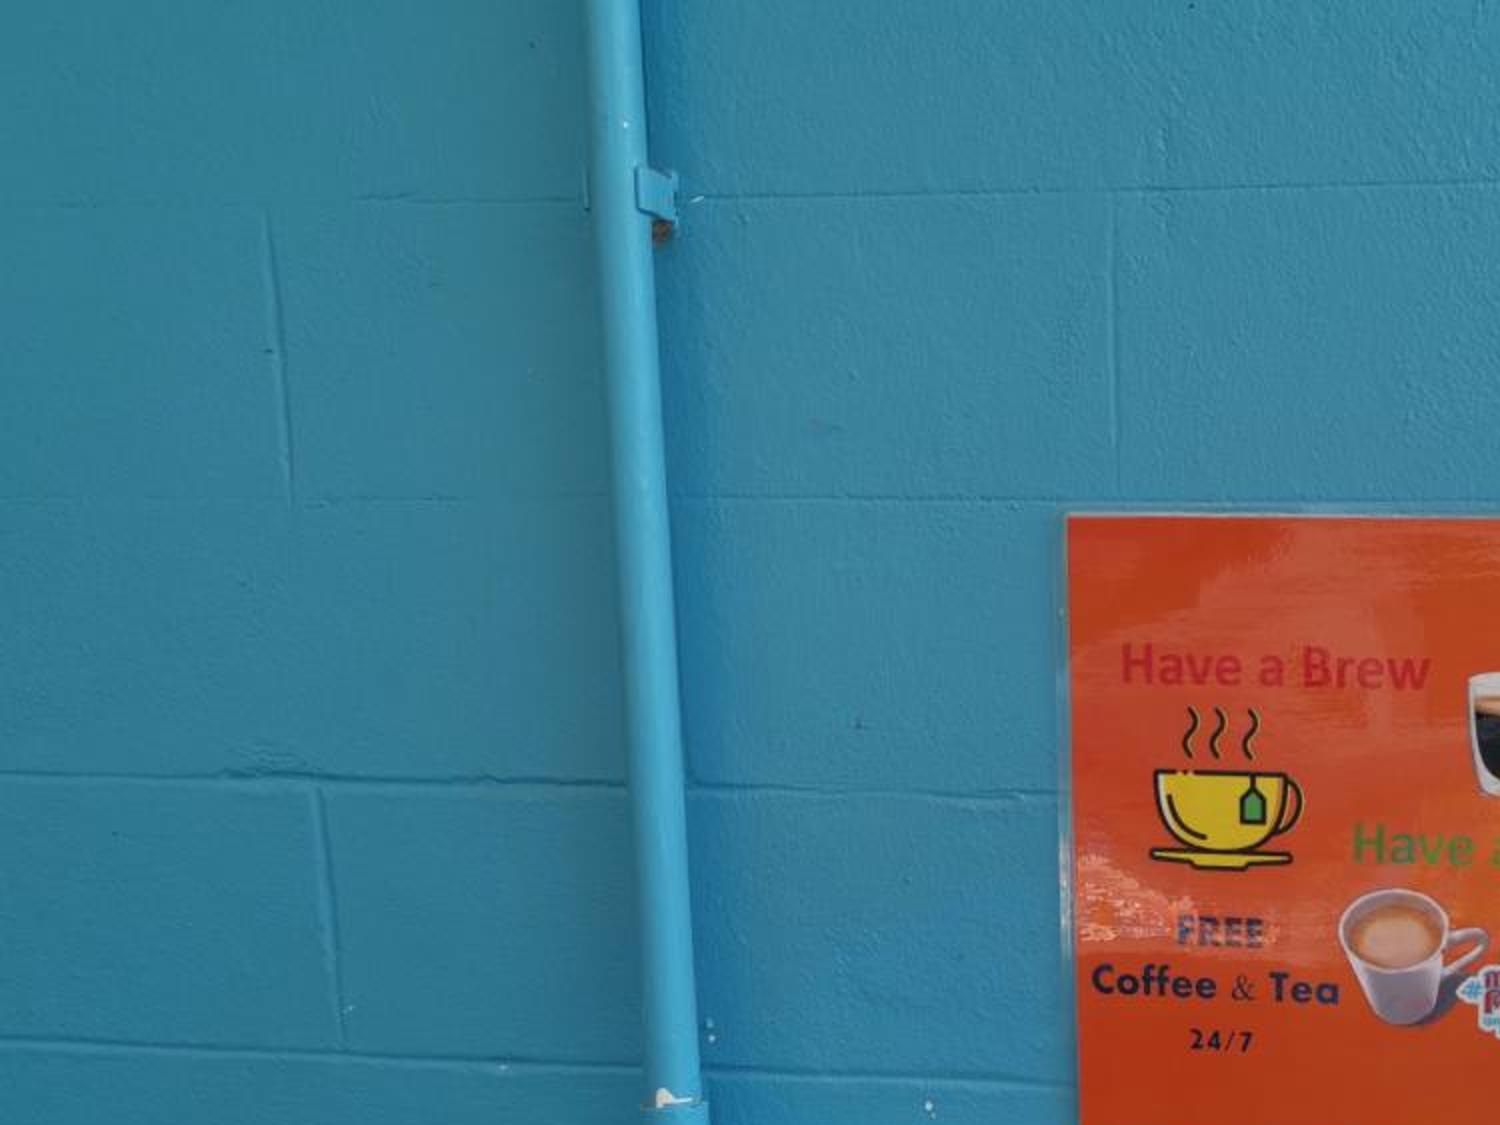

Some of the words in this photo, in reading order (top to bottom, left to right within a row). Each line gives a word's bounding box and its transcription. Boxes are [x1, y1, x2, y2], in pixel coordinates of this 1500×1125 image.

[1121, 642, 1242, 687] Have
[1258, 656, 1285, 688] a
[1303, 645, 1432, 692] Brew
[1352, 820, 1475, 867] Have
[1176, 913, 1266, 949] FREE
[1091, 963, 1219, 999] Coffee
[1230, 973, 1258, 1002] &
[1268, 971, 1341, 1005] Tea
[1189, 1028, 1254, 1054] 24/7
